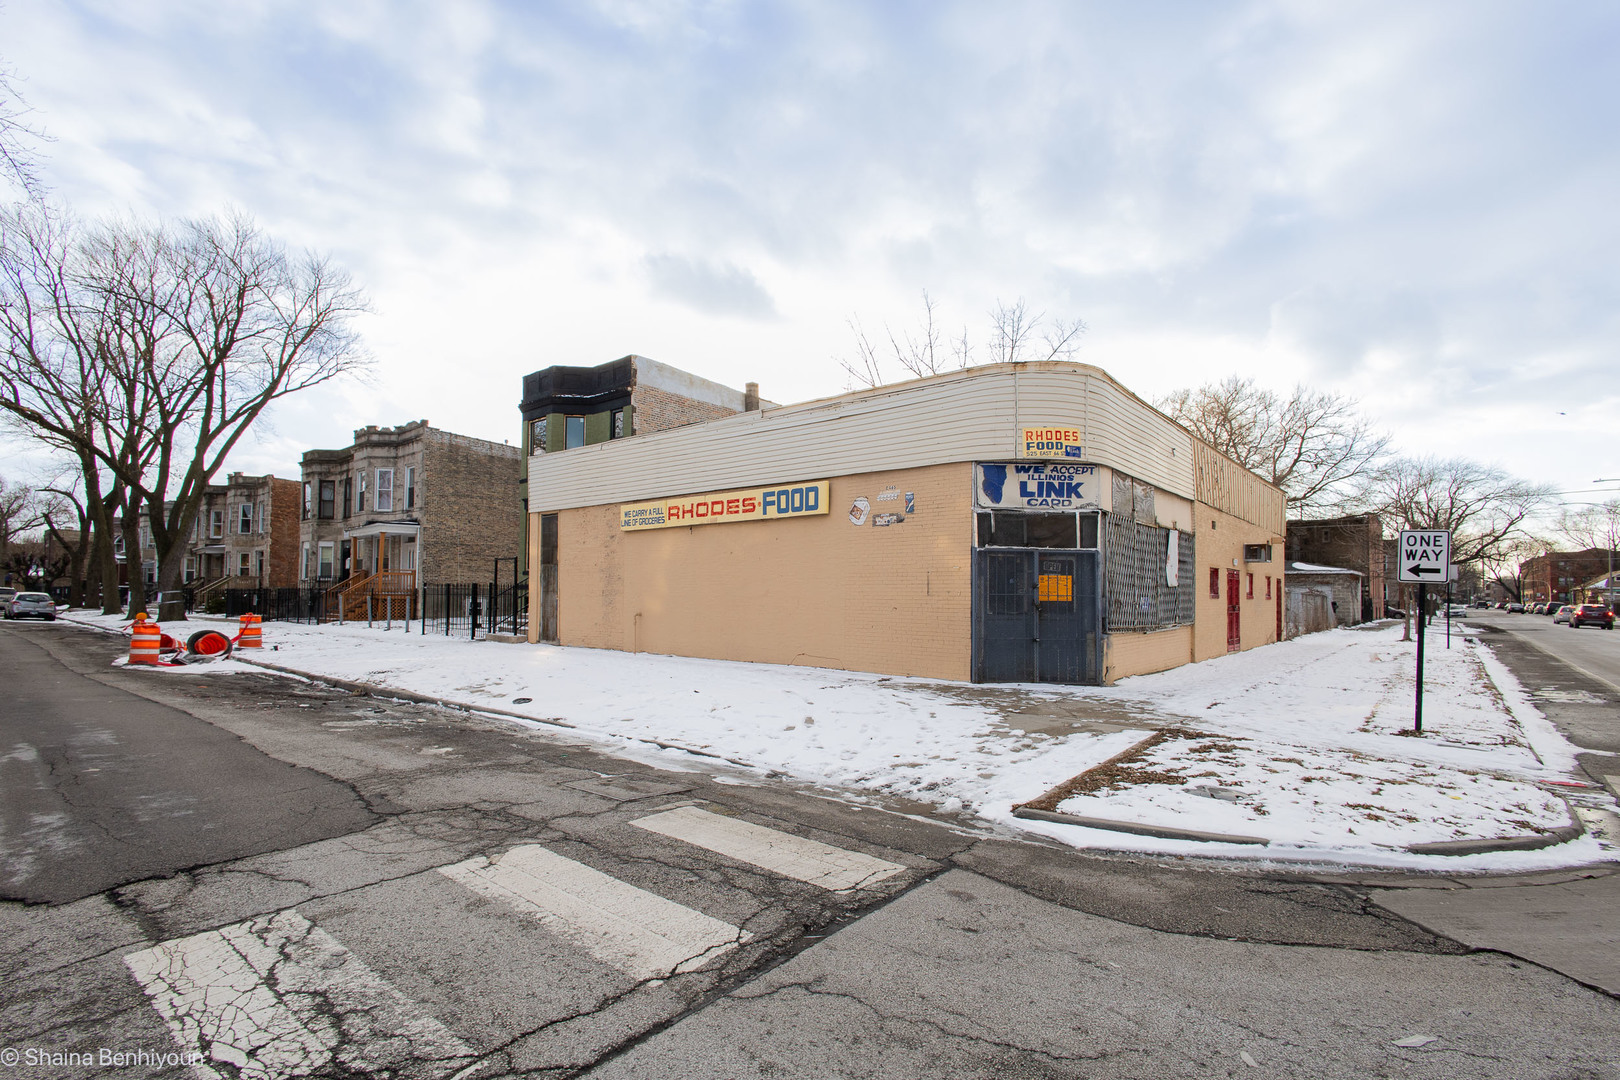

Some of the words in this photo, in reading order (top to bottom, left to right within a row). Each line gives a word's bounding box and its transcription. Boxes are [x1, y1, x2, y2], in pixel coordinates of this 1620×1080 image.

[1025, 430, 1078, 442] RHODES
[1026, 441, 1063, 451] FOOD
[1014, 465, 1045, 474] WE
[1050, 465, 1095, 475] ACCEPT
[1020, 481, 1084, 499] LINK
[668, 497, 757, 521] RHODES
[762, 486, 819, 516] FOOD
[1026, 498, 1073, 507] CARD
[632, 508, 648, 518] CARRY
[652, 507, 664, 515] FULL
[621, 519, 631, 527] LINE
[632, 518, 639, 526] OF
[638, 516, 665, 526] GROCERIES
[1406, 535, 1443, 547] ONE
[1405, 549, 1443, 561] WAY
